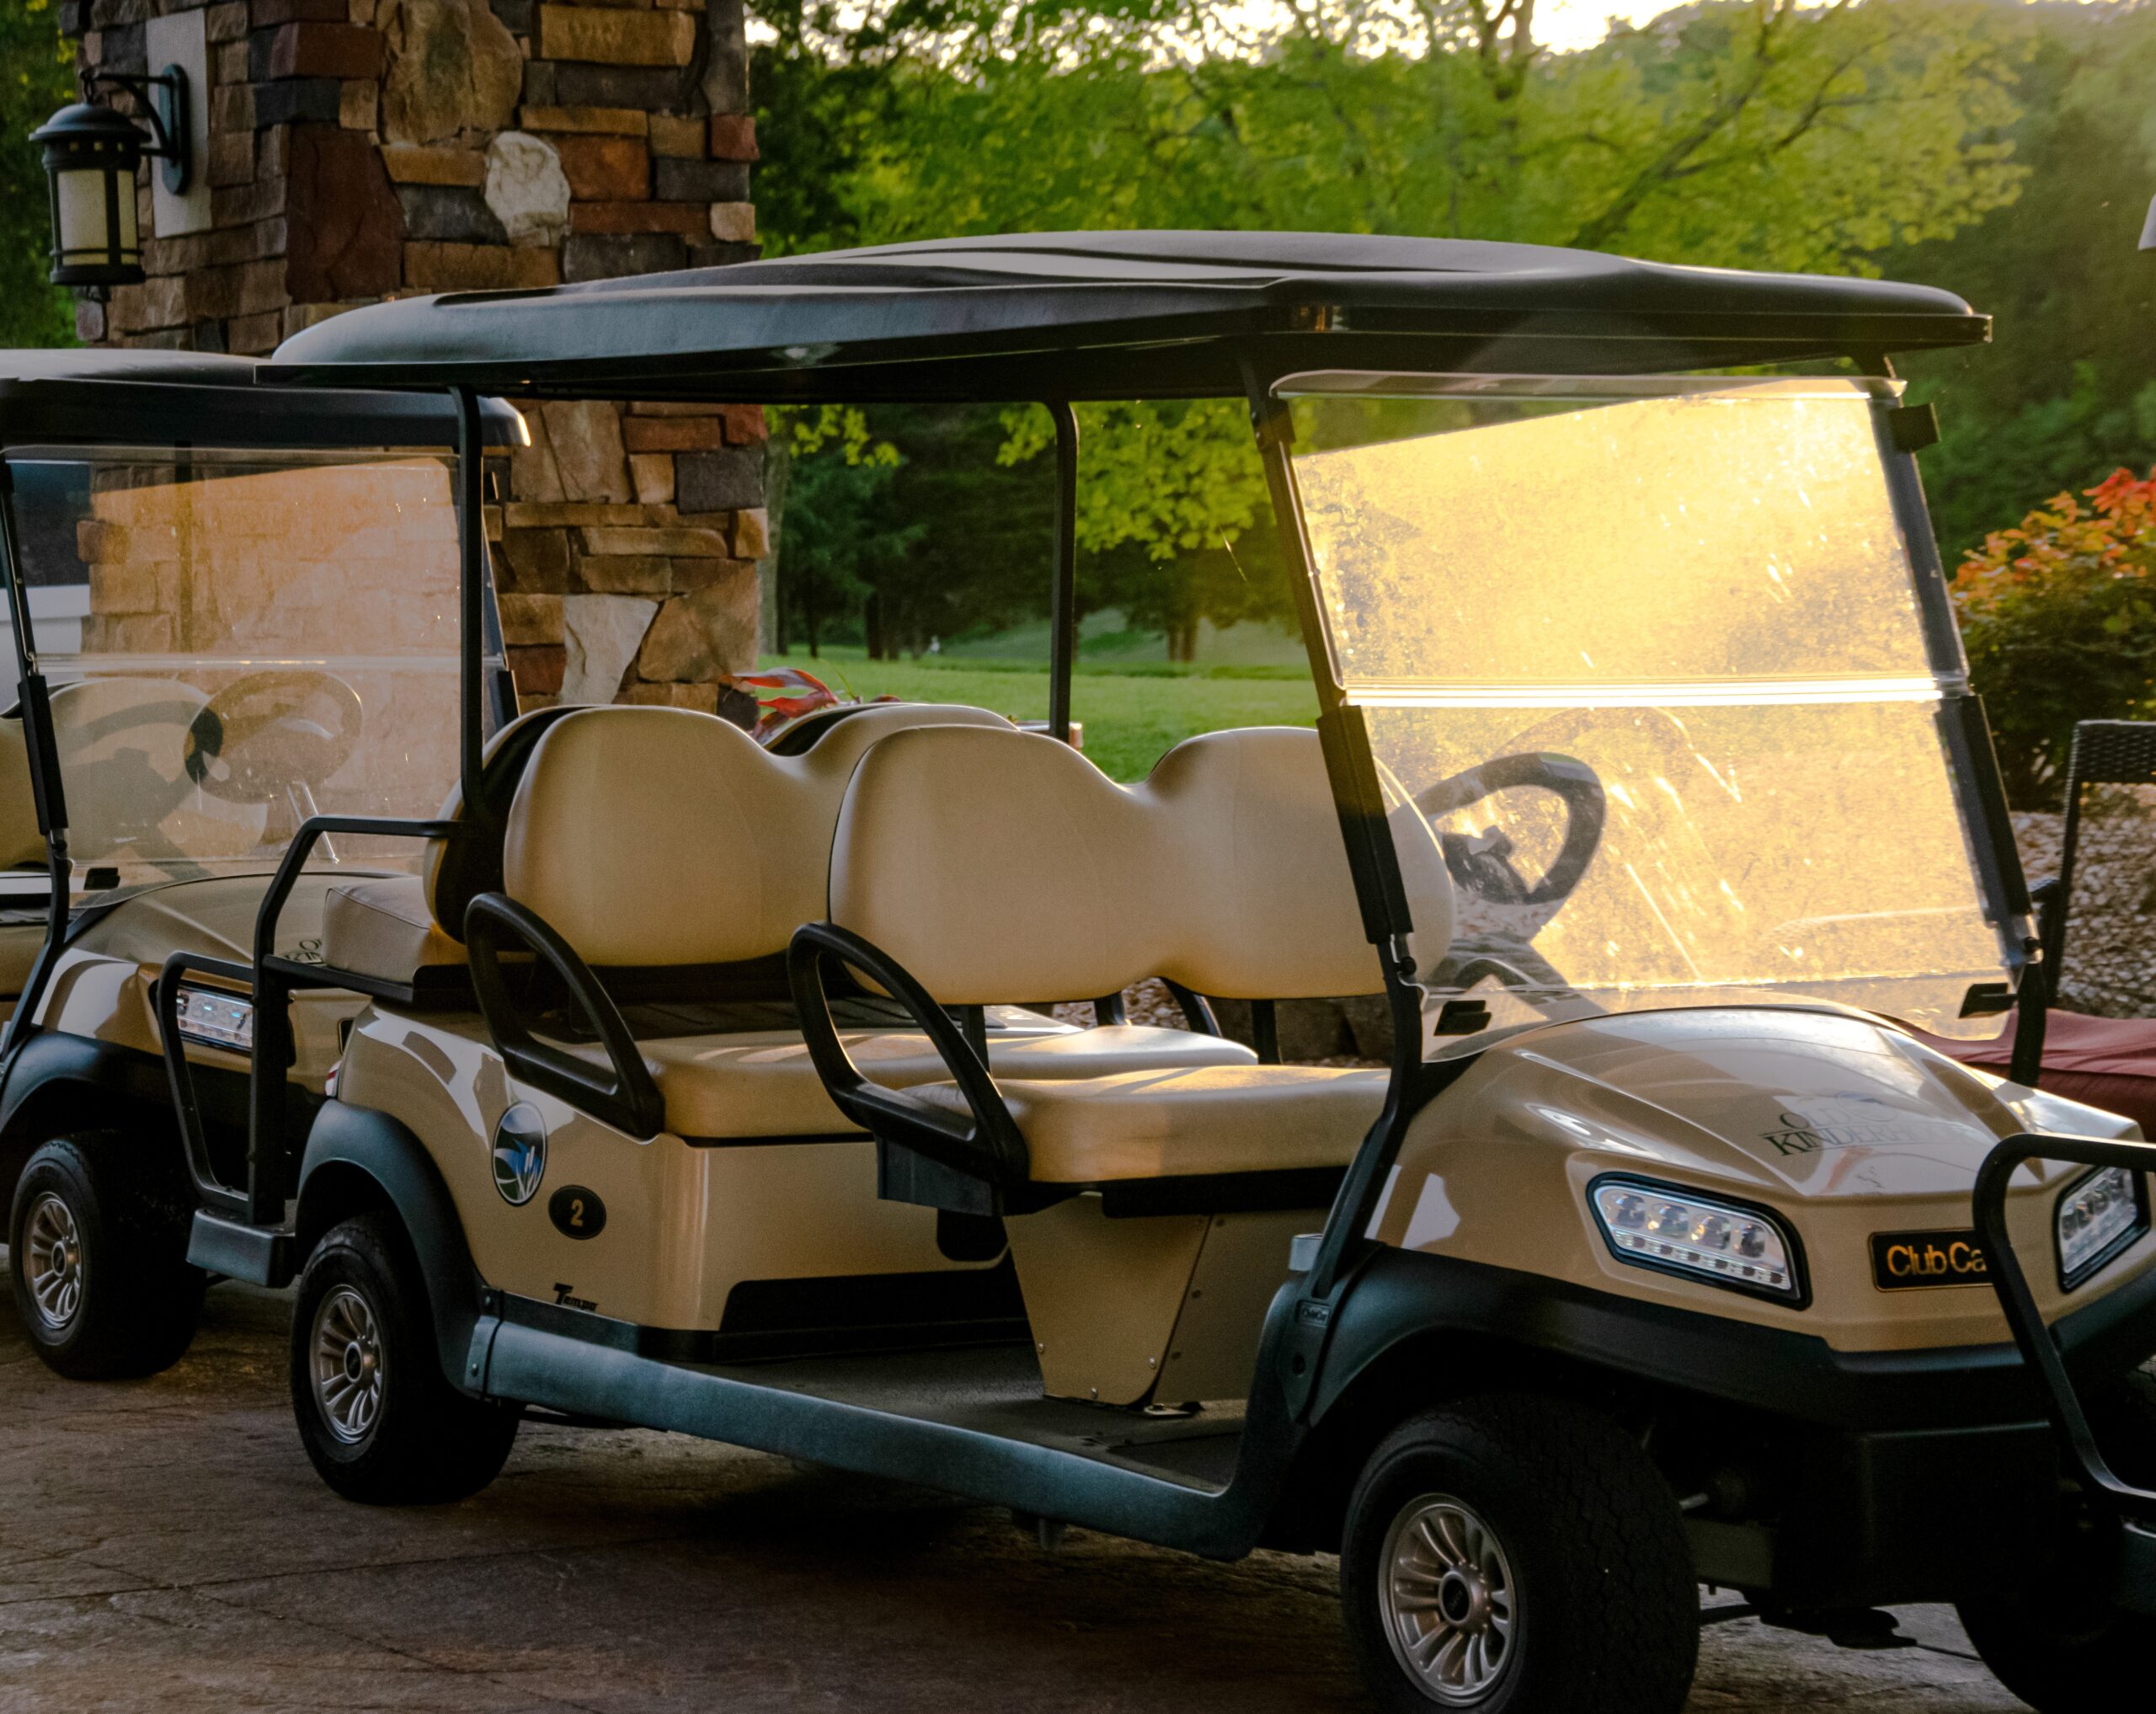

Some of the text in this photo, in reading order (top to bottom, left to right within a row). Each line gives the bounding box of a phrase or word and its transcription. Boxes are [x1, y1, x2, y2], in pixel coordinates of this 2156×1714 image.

[1780, 1109, 1852, 1129] OLD
[570, 1199, 584, 1227] 2
[1886, 1241, 1988, 1277] Club Ca
[553, 1283, 598, 1311] Tempo
